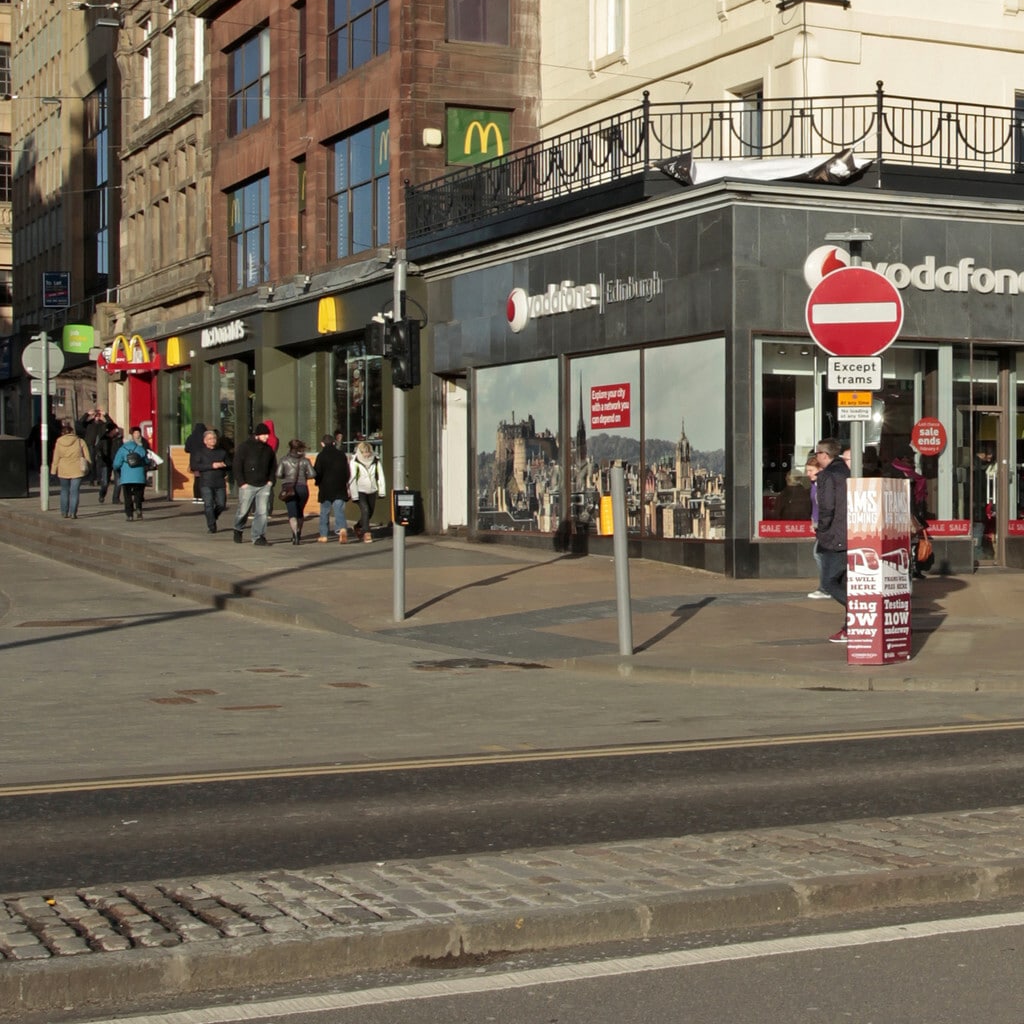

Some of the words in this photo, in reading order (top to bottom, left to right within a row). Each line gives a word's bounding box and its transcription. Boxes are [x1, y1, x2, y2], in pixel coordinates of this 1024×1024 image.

[527, 279, 600, 318] vodafone
[606, 270, 664, 303] Edinburgh
[833, 362, 877, 374] Except
[837, 375, 872, 384] trams
[920, 428, 940, 436] sale
[918, 437, 941, 445] ends
[949, 524, 968, 532] SALE
[884, 599, 909, 611] Testing
[884, 626, 909, 636] underway
